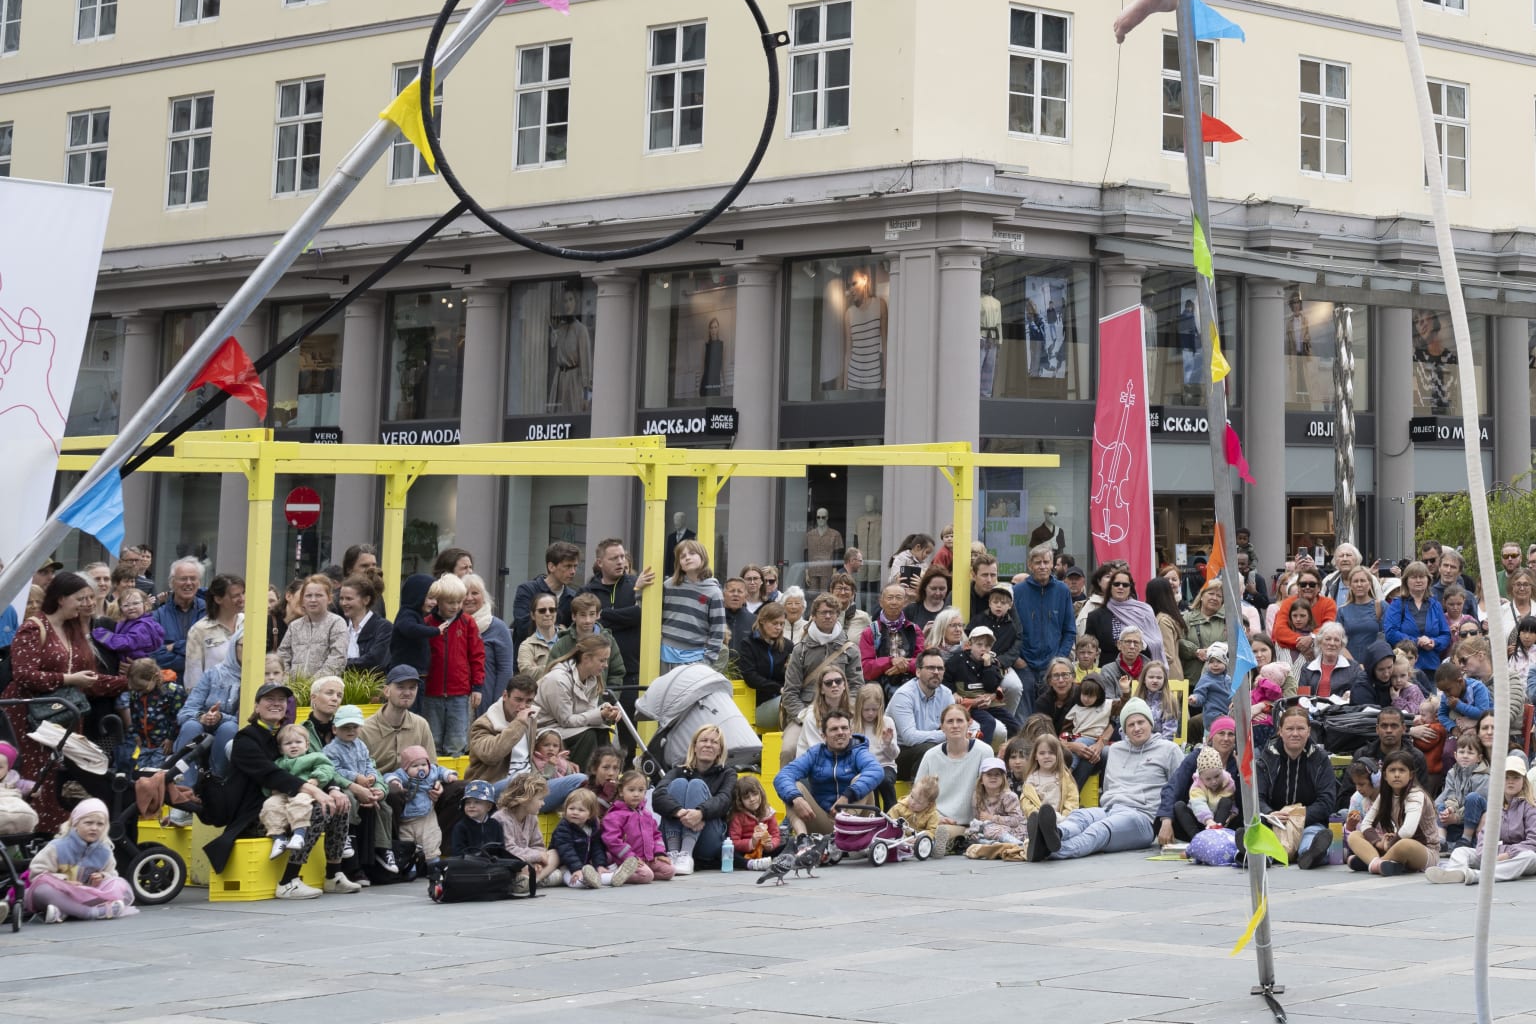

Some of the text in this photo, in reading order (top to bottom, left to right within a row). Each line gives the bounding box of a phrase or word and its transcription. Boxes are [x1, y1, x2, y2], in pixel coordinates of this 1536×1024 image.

[710, 414, 734, 422] JACK&
[315, 432, 338, 440] VERO
[382, 429, 461, 445] VERO MODA
[525, 423, 572, 440] .OBJECT
[986, 520, 1008, 532] STAY
